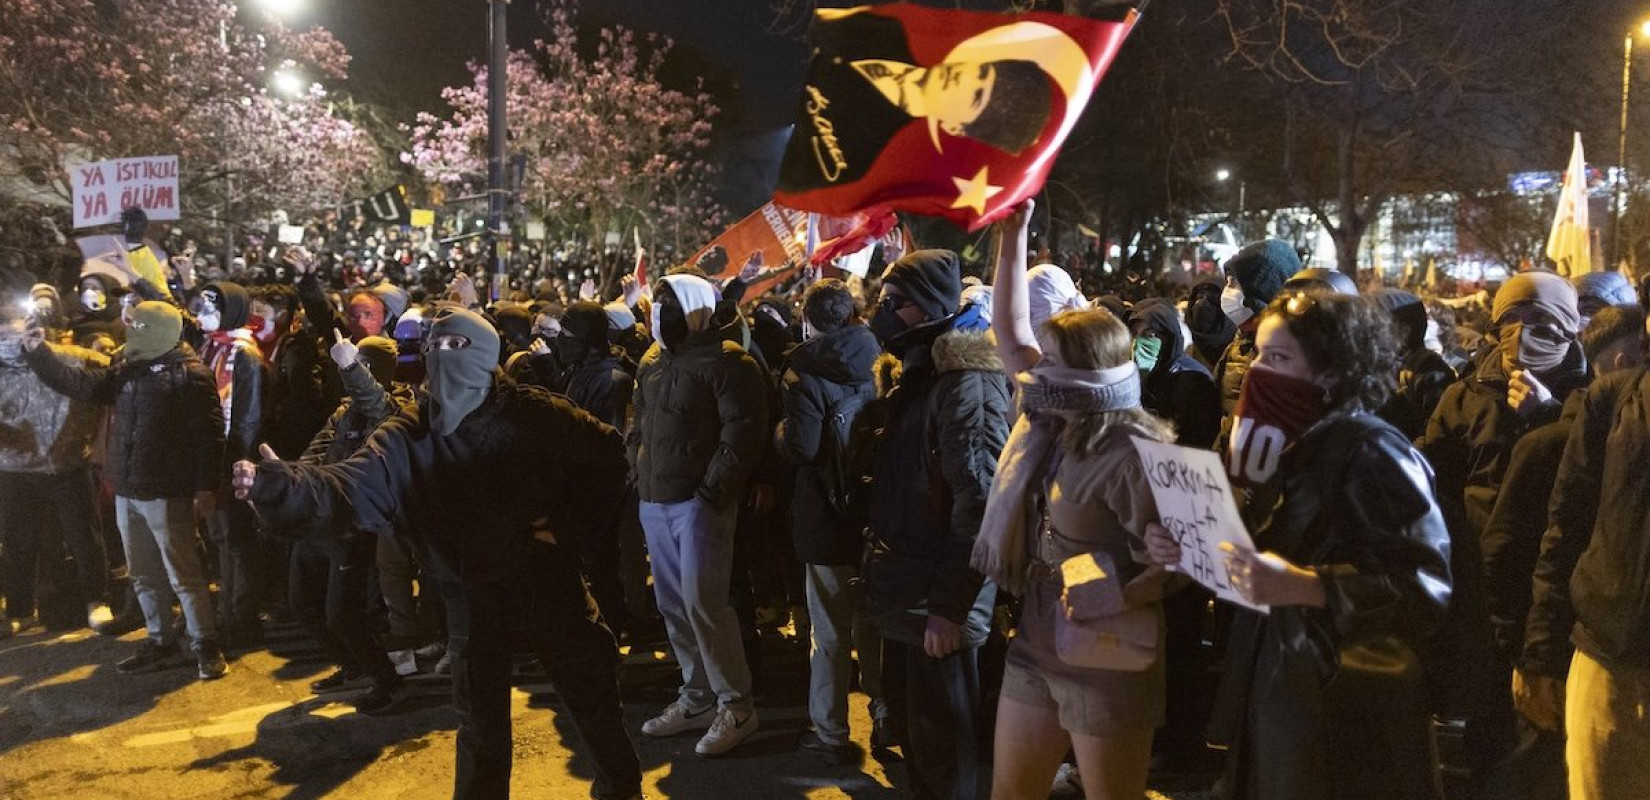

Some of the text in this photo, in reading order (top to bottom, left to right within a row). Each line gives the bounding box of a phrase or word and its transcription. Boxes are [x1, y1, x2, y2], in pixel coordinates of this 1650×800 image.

[80, 165, 105, 187] YA
[81, 184, 174, 219] YA ÖLÜM
[1143, 452, 1223, 504] KORKMA
[1190, 499, 1218, 531] LA
[1191, 551, 1232, 592] HAL
